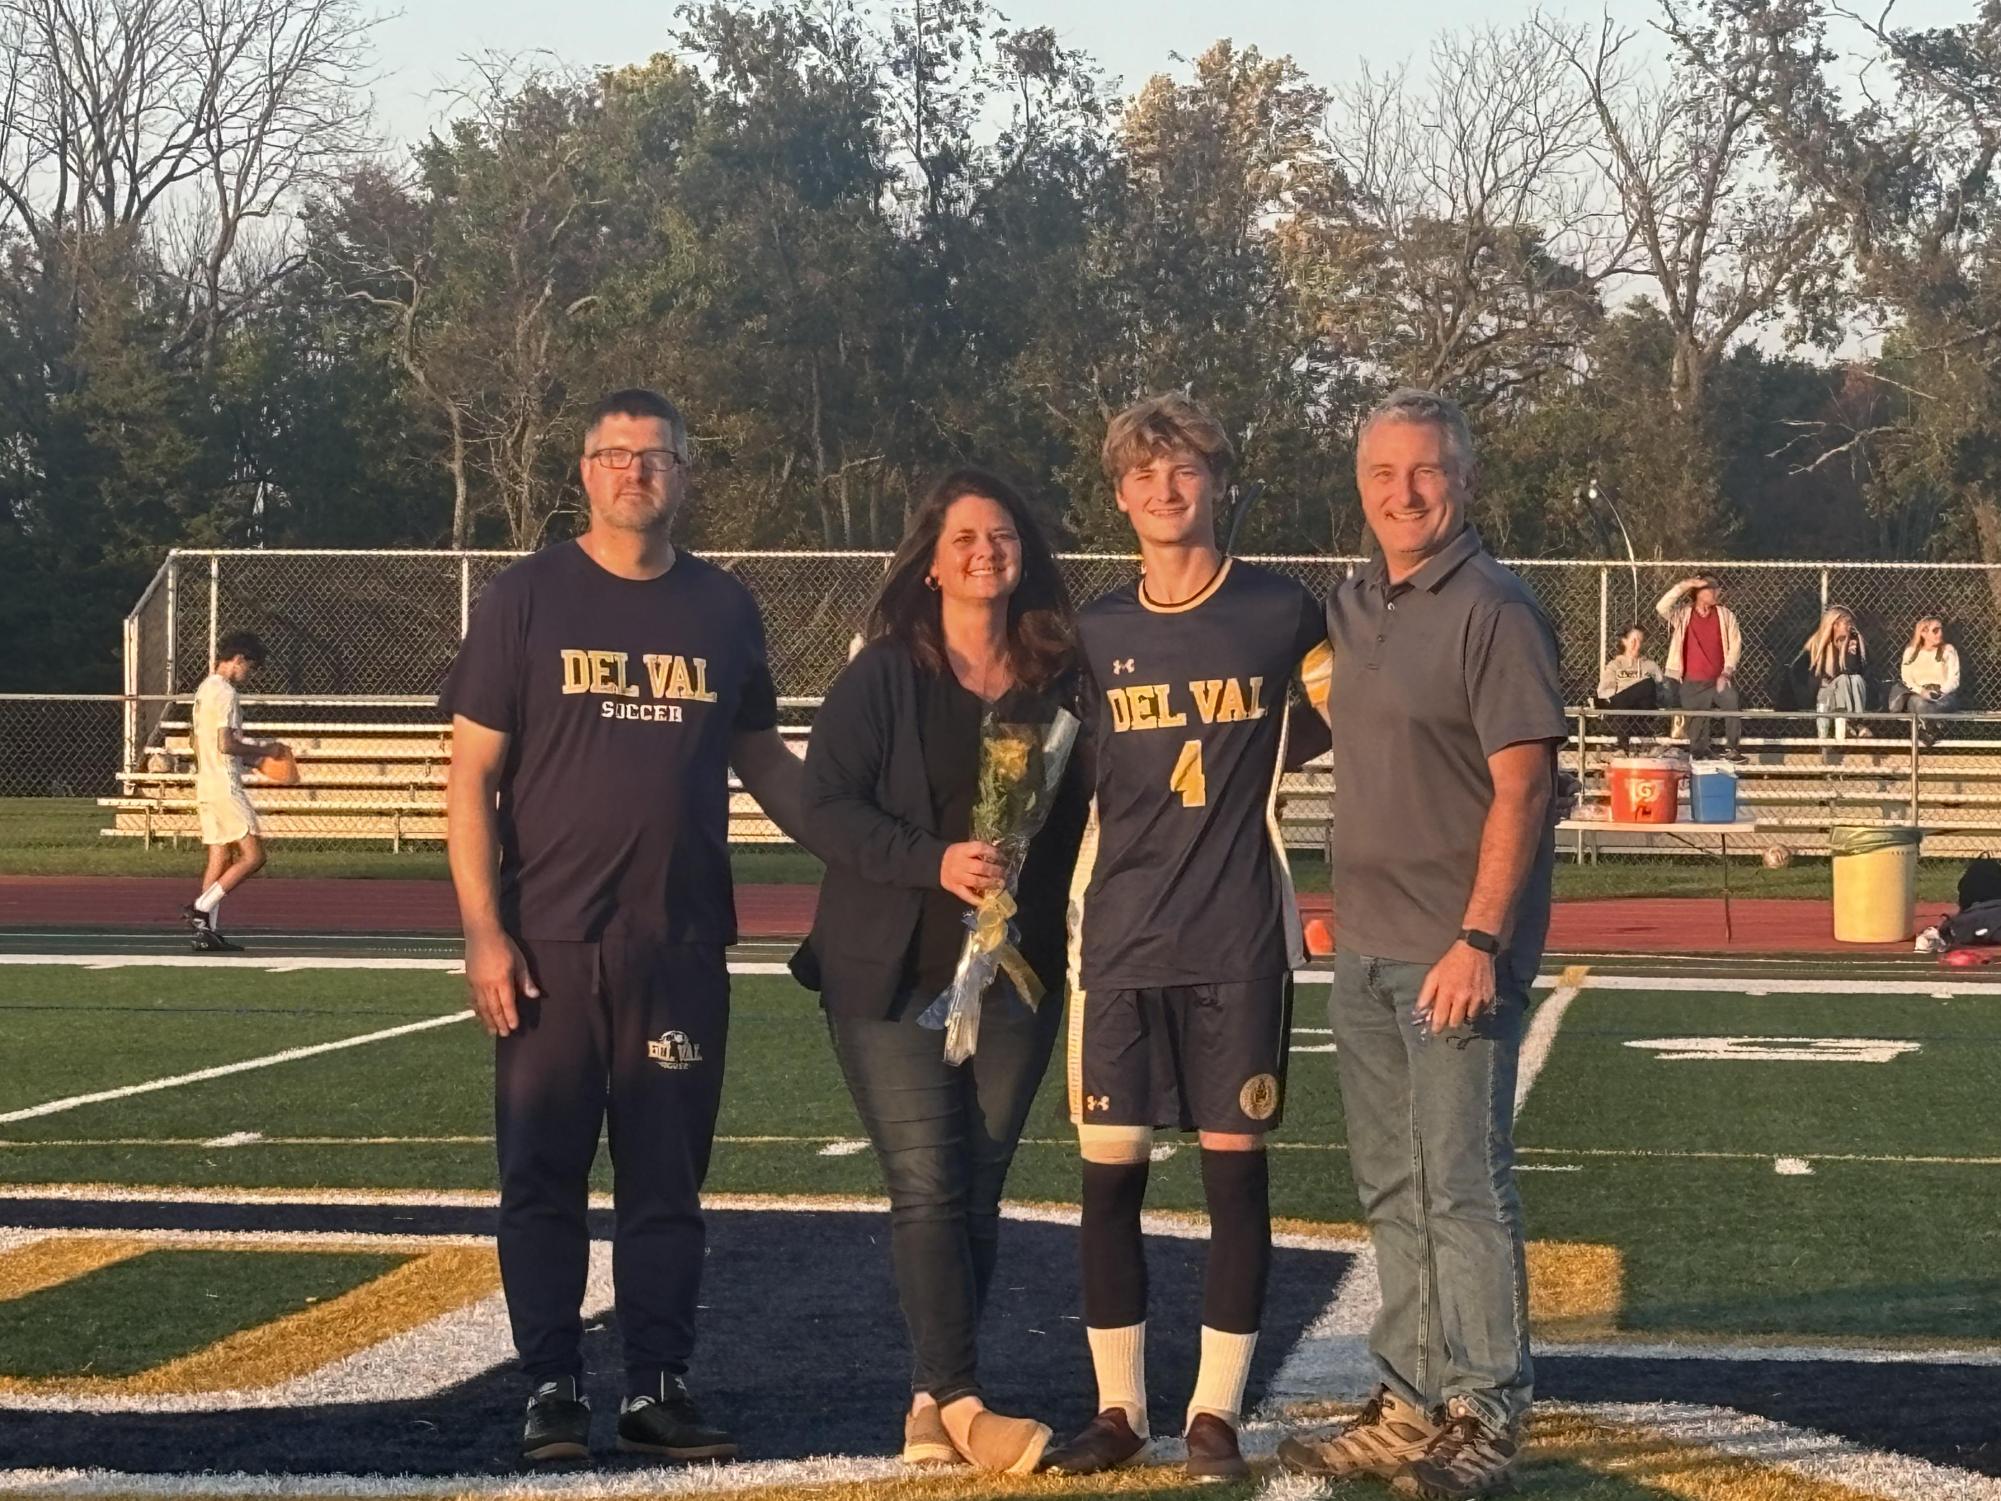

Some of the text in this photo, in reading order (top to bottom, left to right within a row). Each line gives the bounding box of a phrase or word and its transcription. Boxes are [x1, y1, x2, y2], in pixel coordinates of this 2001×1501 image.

[560, 649, 717, 702] DEL VAL
[601, 701, 683, 722] SOCCER
[1106, 676, 1269, 732] DEL VAL
[1170, 739, 1206, 807] 4
